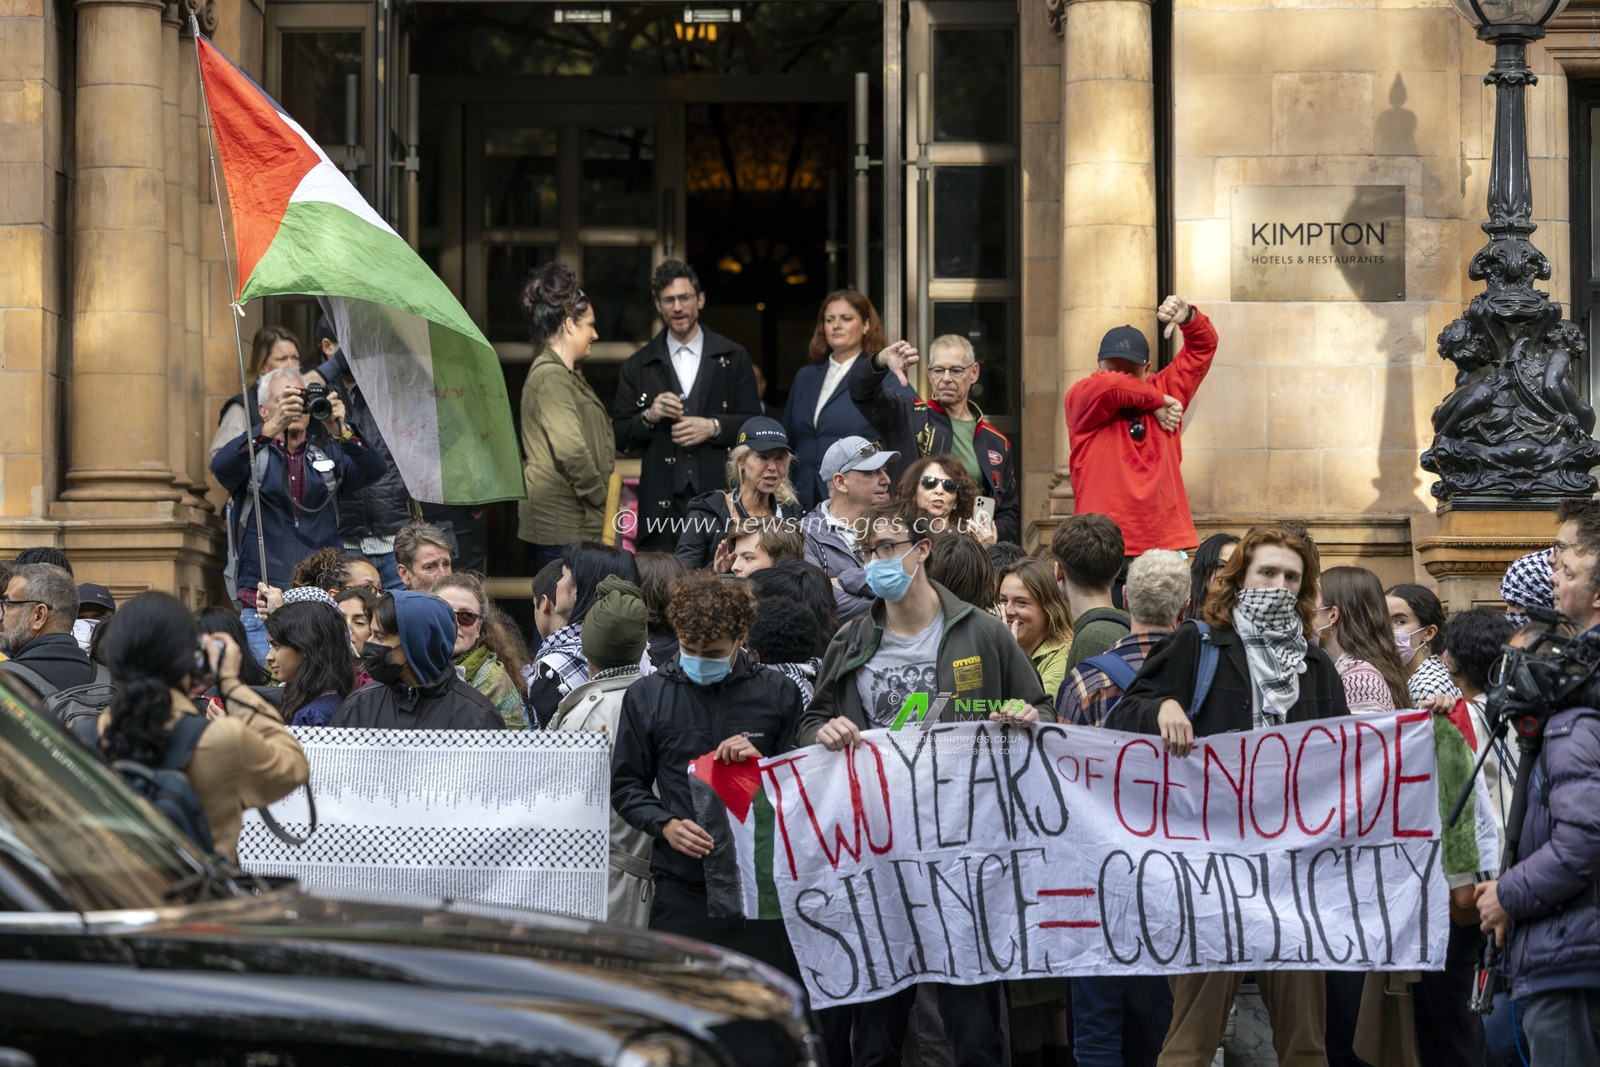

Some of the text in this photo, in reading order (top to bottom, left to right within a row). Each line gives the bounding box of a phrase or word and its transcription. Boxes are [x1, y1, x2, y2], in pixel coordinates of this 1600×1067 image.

[1251, 255, 1386, 265] HOTELS & RESTAURANTS
[758, 739, 894, 882] TWO
[887, 722, 1069, 851] YEARS
[1056, 755, 1105, 790] OF
[1113, 711, 1434, 842] GENOCIDE
